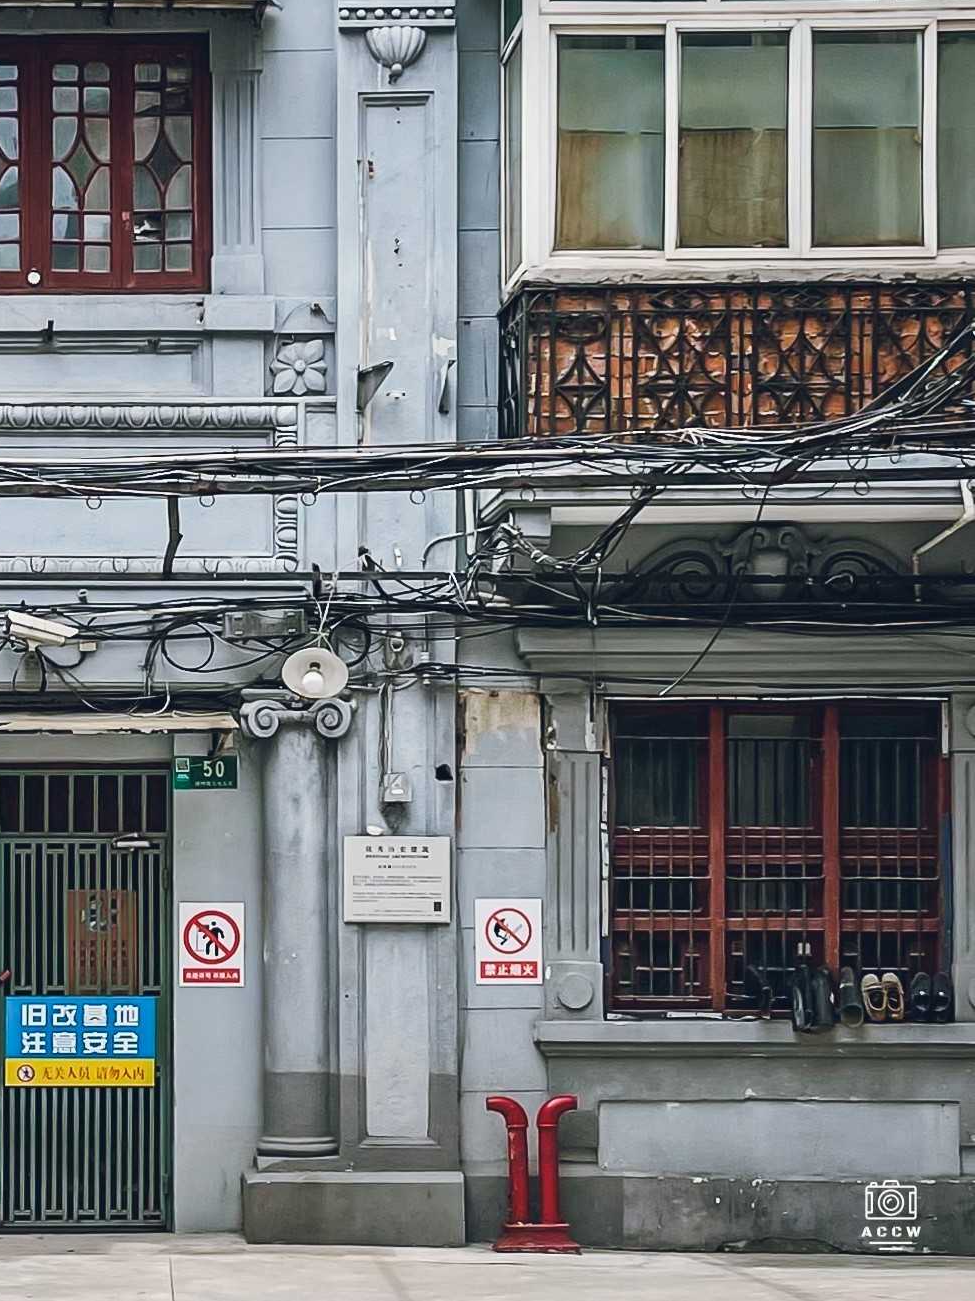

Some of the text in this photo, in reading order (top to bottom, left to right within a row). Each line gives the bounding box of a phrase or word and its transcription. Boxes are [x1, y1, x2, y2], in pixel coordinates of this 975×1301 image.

[203, 760, 225, 778] 50
[21, 1003, 139, 1027] 旧改基地
[21, 1031, 139, 1054] 注意安全
[41, 1065, 146, 1081] 无关人员 请勿入内
